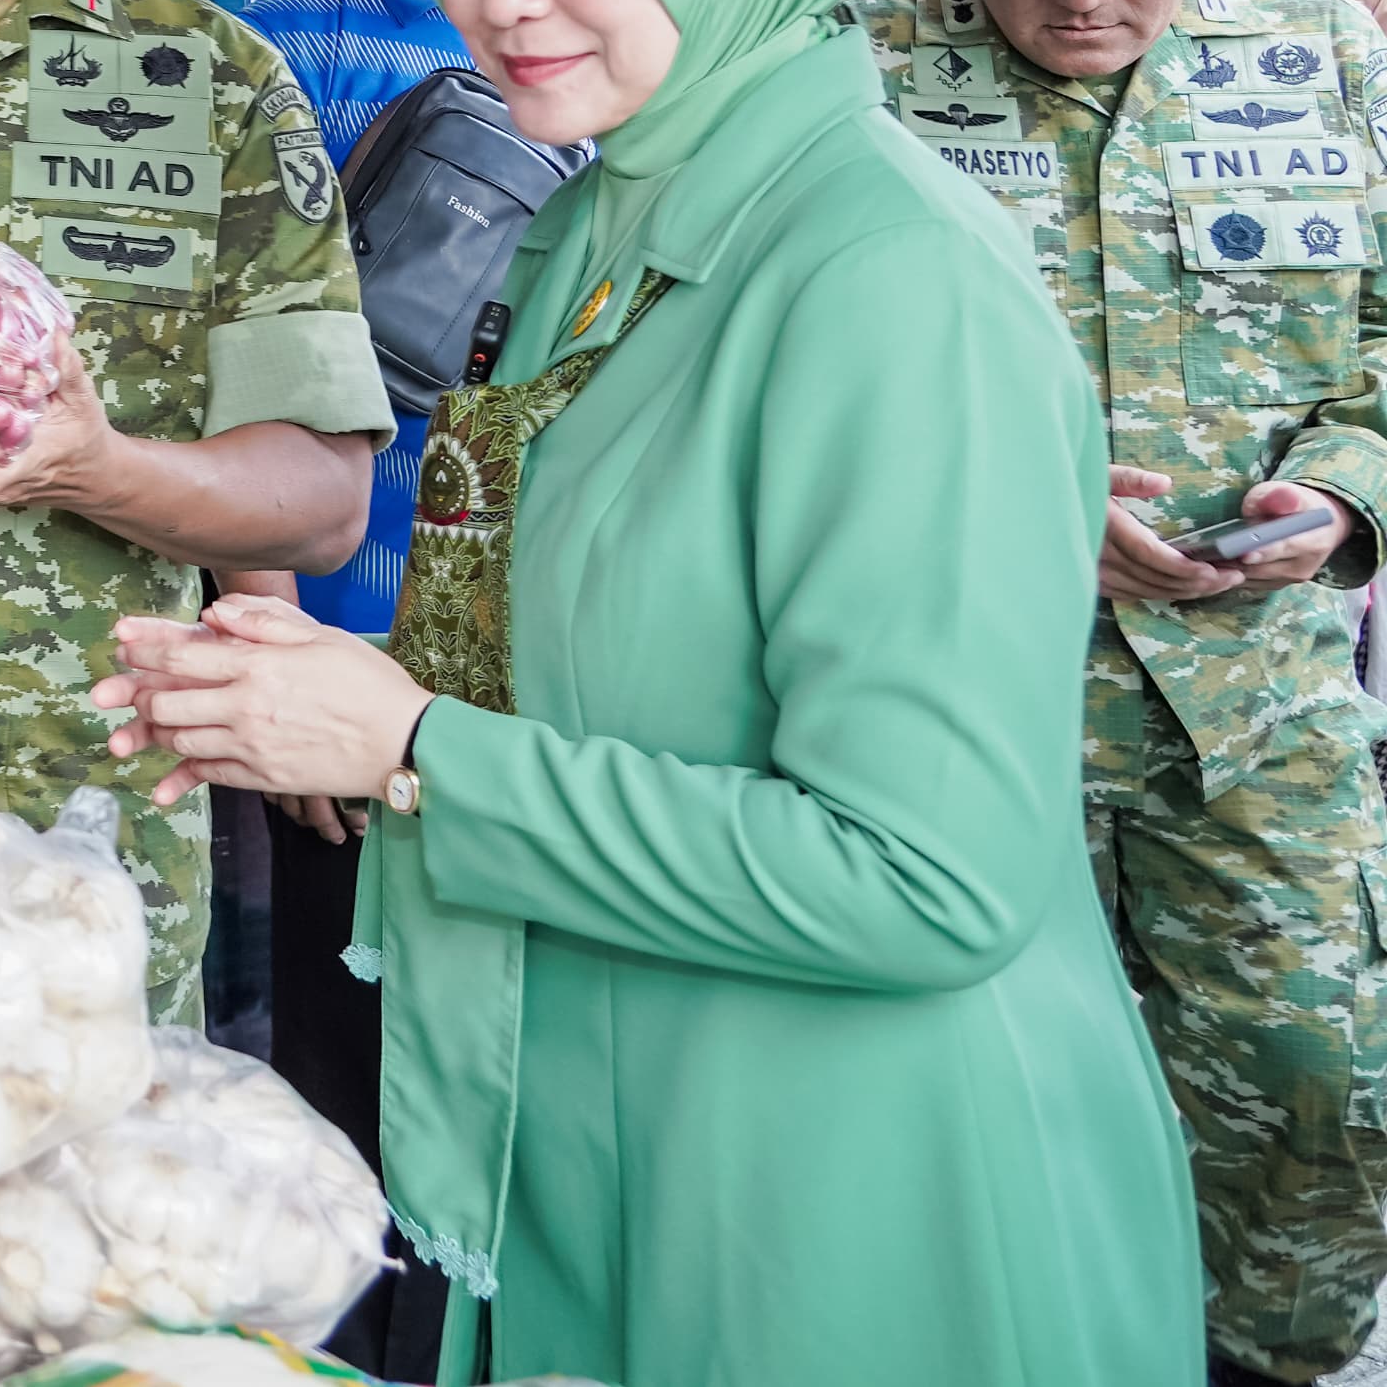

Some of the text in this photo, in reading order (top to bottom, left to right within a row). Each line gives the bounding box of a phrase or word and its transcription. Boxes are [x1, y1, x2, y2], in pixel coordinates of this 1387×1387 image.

[39, 155, 195, 197] TNI AD
[939, 147, 1052, 179] PRASETYO
[1180, 147, 1349, 179] TNI AD
[446, 194, 491, 230] Fashion
